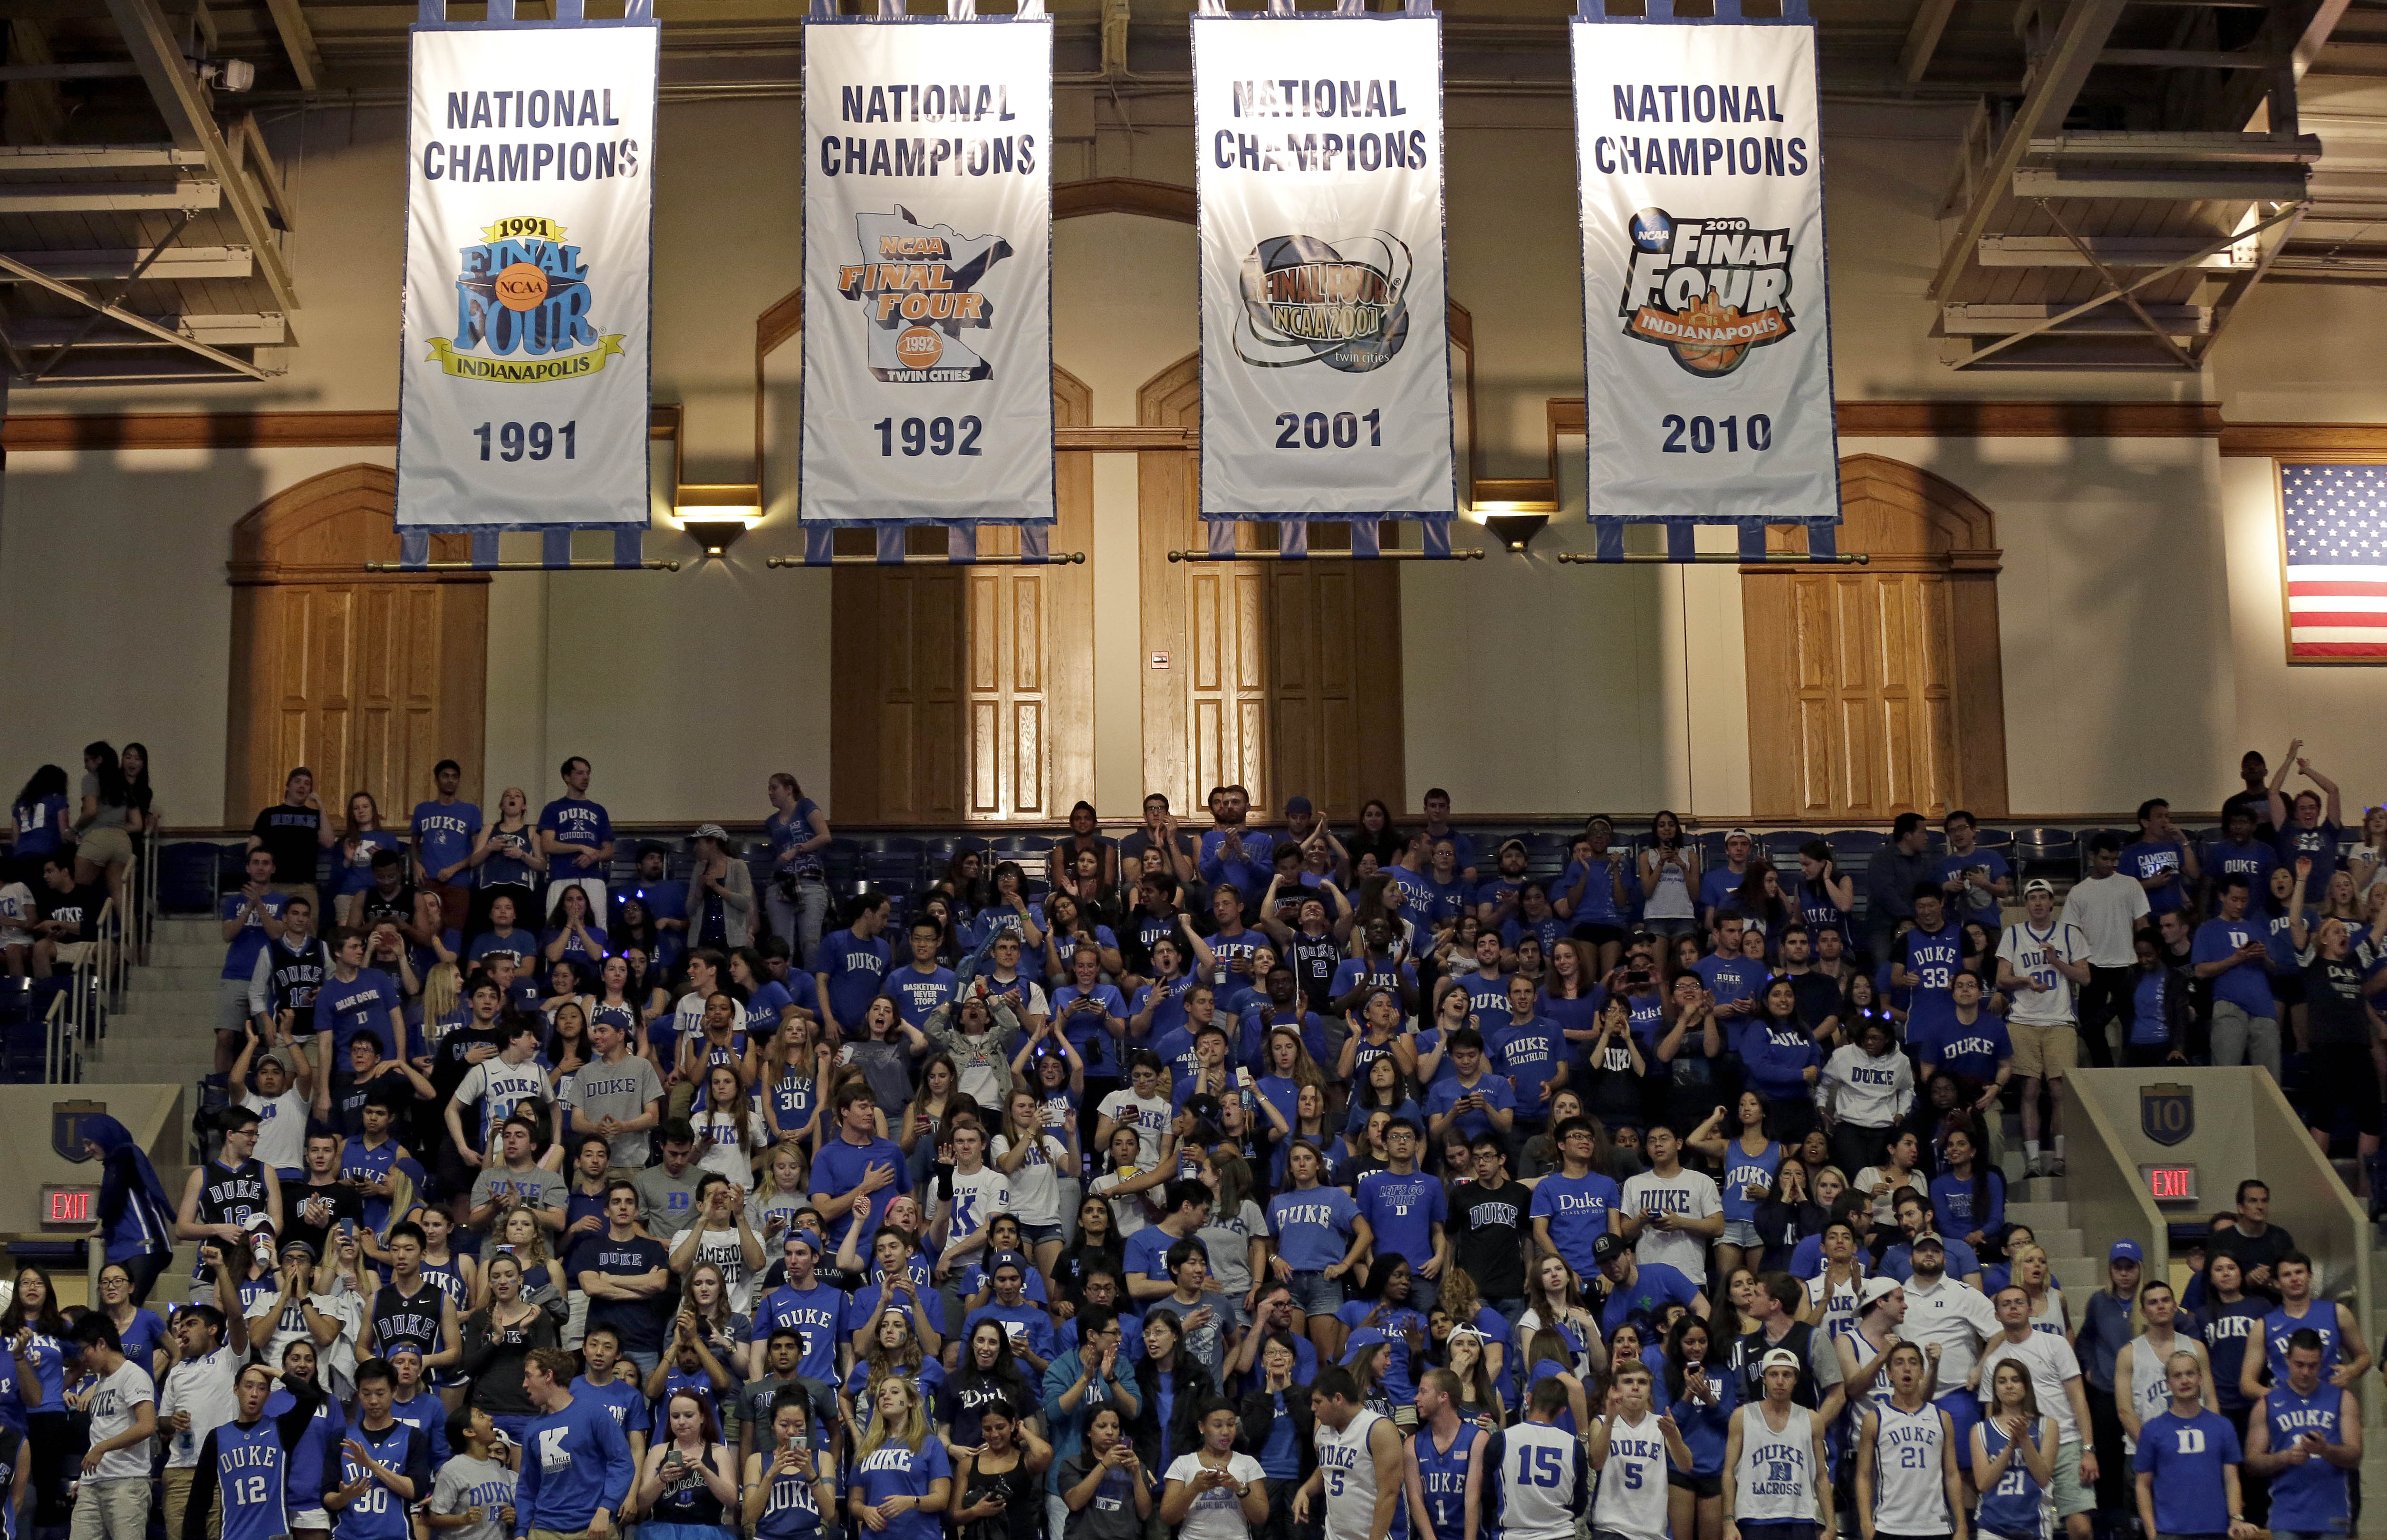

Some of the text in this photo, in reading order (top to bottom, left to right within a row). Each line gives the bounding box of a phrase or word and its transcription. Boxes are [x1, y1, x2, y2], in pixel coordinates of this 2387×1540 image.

[446, 88, 619, 129] NATIONAL
[842, 84, 1016, 123] NATIONAL
[1233, 79, 1407, 118] NATIONAL
[1613, 84, 1783, 123] NATIONAL
[424, 138, 639, 183] CHAMPIONS
[821, 135, 1035, 176] CHAMPIONS
[1214, 129, 1426, 171] CHAMPIONS
[1595, 136, 1807, 176] CHAMPIONS
[498, 218, 549, 237] 1991
[1638, 230, 1669, 241] NCAA
[1705, 221, 1747, 231] 2010
[879, 236, 944, 255] NCAA
[1671, 224, 1789, 265] FINAL
[458, 239, 589, 281] FINAL
[500, 281, 543, 294] NCAA
[838, 263, 953, 291] FINAL
[1258, 264, 1391, 306] FINAL FOUR
[1626, 253, 1789, 313] FOUR
[875, 291, 984, 320] FOUR
[454, 280, 597, 356] FOUR
[1273, 307, 1379, 341] NCAA 2001
[1641, 315, 1778, 340] INDIANAPOLIS
[905, 336, 934, 352] 1992
[1335, 351, 1389, 363] twin cities
[457, 357, 590, 380] INDIANAPOLIS
[887, 370, 971, 382] TWIN CITIES
[874, 415, 982, 457] 1992
[1275, 408, 1381, 449] 2001
[1662, 414, 1771, 453] 2010
[473, 420, 576, 462] 1991
[270, 813, 316, 828] DUKE
[421, 816, 466, 835] DUKE
[558, 808, 597, 826] DUKE
[559, 831, 595, 841] QUIDDITCH
[2224, 859, 2259, 874] DUKE
[1396, 881, 1434, 902] Duke
[1298, 944, 1336, 960] DUKE
[1914, 946, 1956, 966] DUKE
[846, 952, 882, 977] DUKE
[1312, 960, 1328, 978] 2
[276, 965, 322, 987] DUKE
[903, 983, 947, 991] BASKETBALL
[1716, 973, 1741, 982] DUKE
[1923, 967, 1949, 988] 33
[289, 986, 315, 1008] 12
[335, 989, 381, 1011] BLUE DEVIL
[913, 990, 938, 998] NEVER
[914, 997, 937, 1005] STOPS
[745, 1006, 772, 1024] Duke
[1504, 1036, 1550, 1058] DUKE
[1507, 1050, 1548, 1066] TRIATHLON
[1943, 1037, 1995, 1059] DUKE
[1603, 1047, 1631, 1072] UK
[491, 1078, 539, 1097] DUKE
[774, 1075, 813, 1094] DUKE
[1851, 1067, 1895, 1086] DUKE
[586, 1078, 636, 1098] DUKE
[780, 1092, 806, 1110] 30
[1116, 1106, 1165, 1129] DKE
[2151, 1099, 2186, 1131] 10
[1726, 1165, 1773, 1190] DUKE
[2152, 1170, 2189, 1196] EXIT
[210, 1180, 261, 1203] DUKE
[1379, 1184, 1425, 1198] LET'S GO
[1385, 1194, 1416, 1207] DUKE
[1558, 1192, 1605, 1211] Duke
[1640, 1190, 1690, 1213] DUKE
[52, 1193, 90, 1220] EXIT
[223, 1205, 251, 1227] 12
[1276, 1204, 1332, 1231] DUKE
[1469, 1202, 1518, 1230] DUKE
[599, 1253, 642, 1266] DUKE
[696, 1242, 741, 1262] AMERO
[825, 1269, 844, 1278] LAW
[270, 1312, 320, 1332] UK
[378, 1314, 436, 1339] DUKE
[777, 1308, 832, 1328] DUKE
[2205, 1315, 2256, 1348] DUK
[2274, 1328, 2331, 1354] DE
[1086, 1385, 1104, 1405] UK
[2276, 1409, 2335, 1433] DUKE
[1888, 1426, 1936, 1445] DUKE
[220, 1445, 277, 1473] DUKE
[555, 1454, 570, 1463] VILLE
[860, 1449, 915, 1473] DUKE
[1319, 1445, 1357, 1470] DUKE
[1610, 1439, 1661, 1461] DUKE
[1752, 1444, 1804, 1470] DUKE
[1901, 1447, 1926, 1468] 21
[543, 1462, 572, 1473] RESIDENT
[1518, 1444, 1562, 1488] 15
[1625, 1463, 1643, 1489] 5
[235, 1475, 267, 1505] 12
[663, 1470, 708, 1499] Duke
[1330, 1470, 1345, 1496] 5
[1420, 1473, 1465, 1494] UKE
[1996, 1470, 2026, 1496] 21
[354, 1487, 388, 1513] 30
[1194, 1501, 1240, 1511] BLUE DEVILS
[1435, 1499, 1448, 1525] 1
